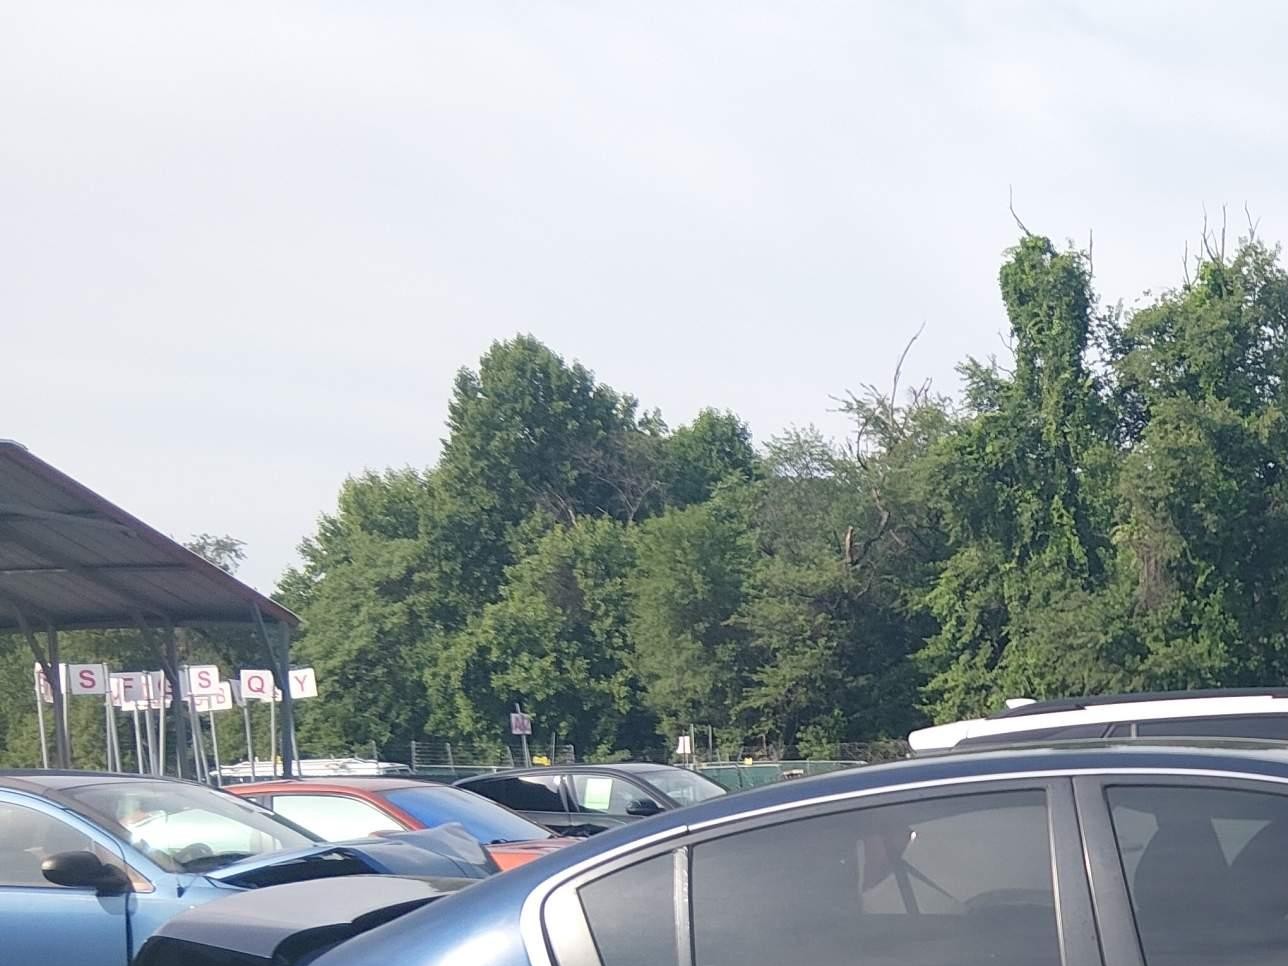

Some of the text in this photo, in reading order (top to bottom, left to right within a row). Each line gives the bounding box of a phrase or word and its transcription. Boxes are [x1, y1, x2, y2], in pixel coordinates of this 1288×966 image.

[79, 669, 96, 689] S
[197, 670, 212, 689] S
[247, 675, 265, 694] Q
[293, 674, 308, 693] Y
